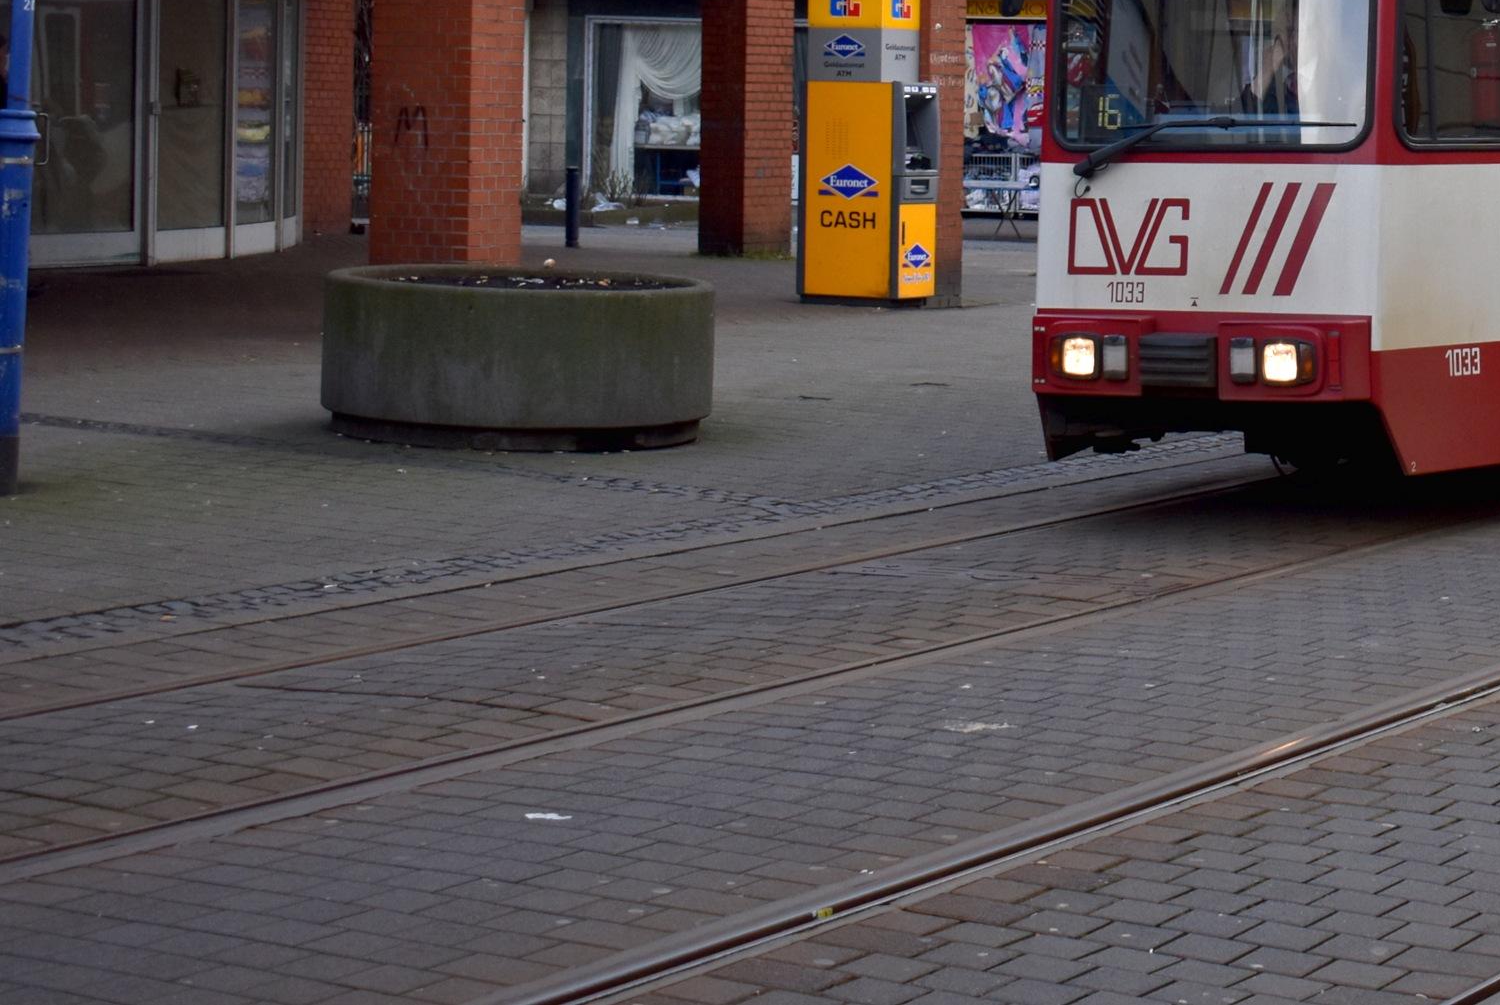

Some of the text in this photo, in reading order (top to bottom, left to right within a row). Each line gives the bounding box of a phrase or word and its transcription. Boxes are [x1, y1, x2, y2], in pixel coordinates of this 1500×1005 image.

[829, 174, 869, 188] Euronet
[820, 209, 876, 229] CASH
[1067, 198, 1191, 276] DVG
[1106, 281, 1145, 303] 1033
[1445, 346, 1481, 377] 1033
